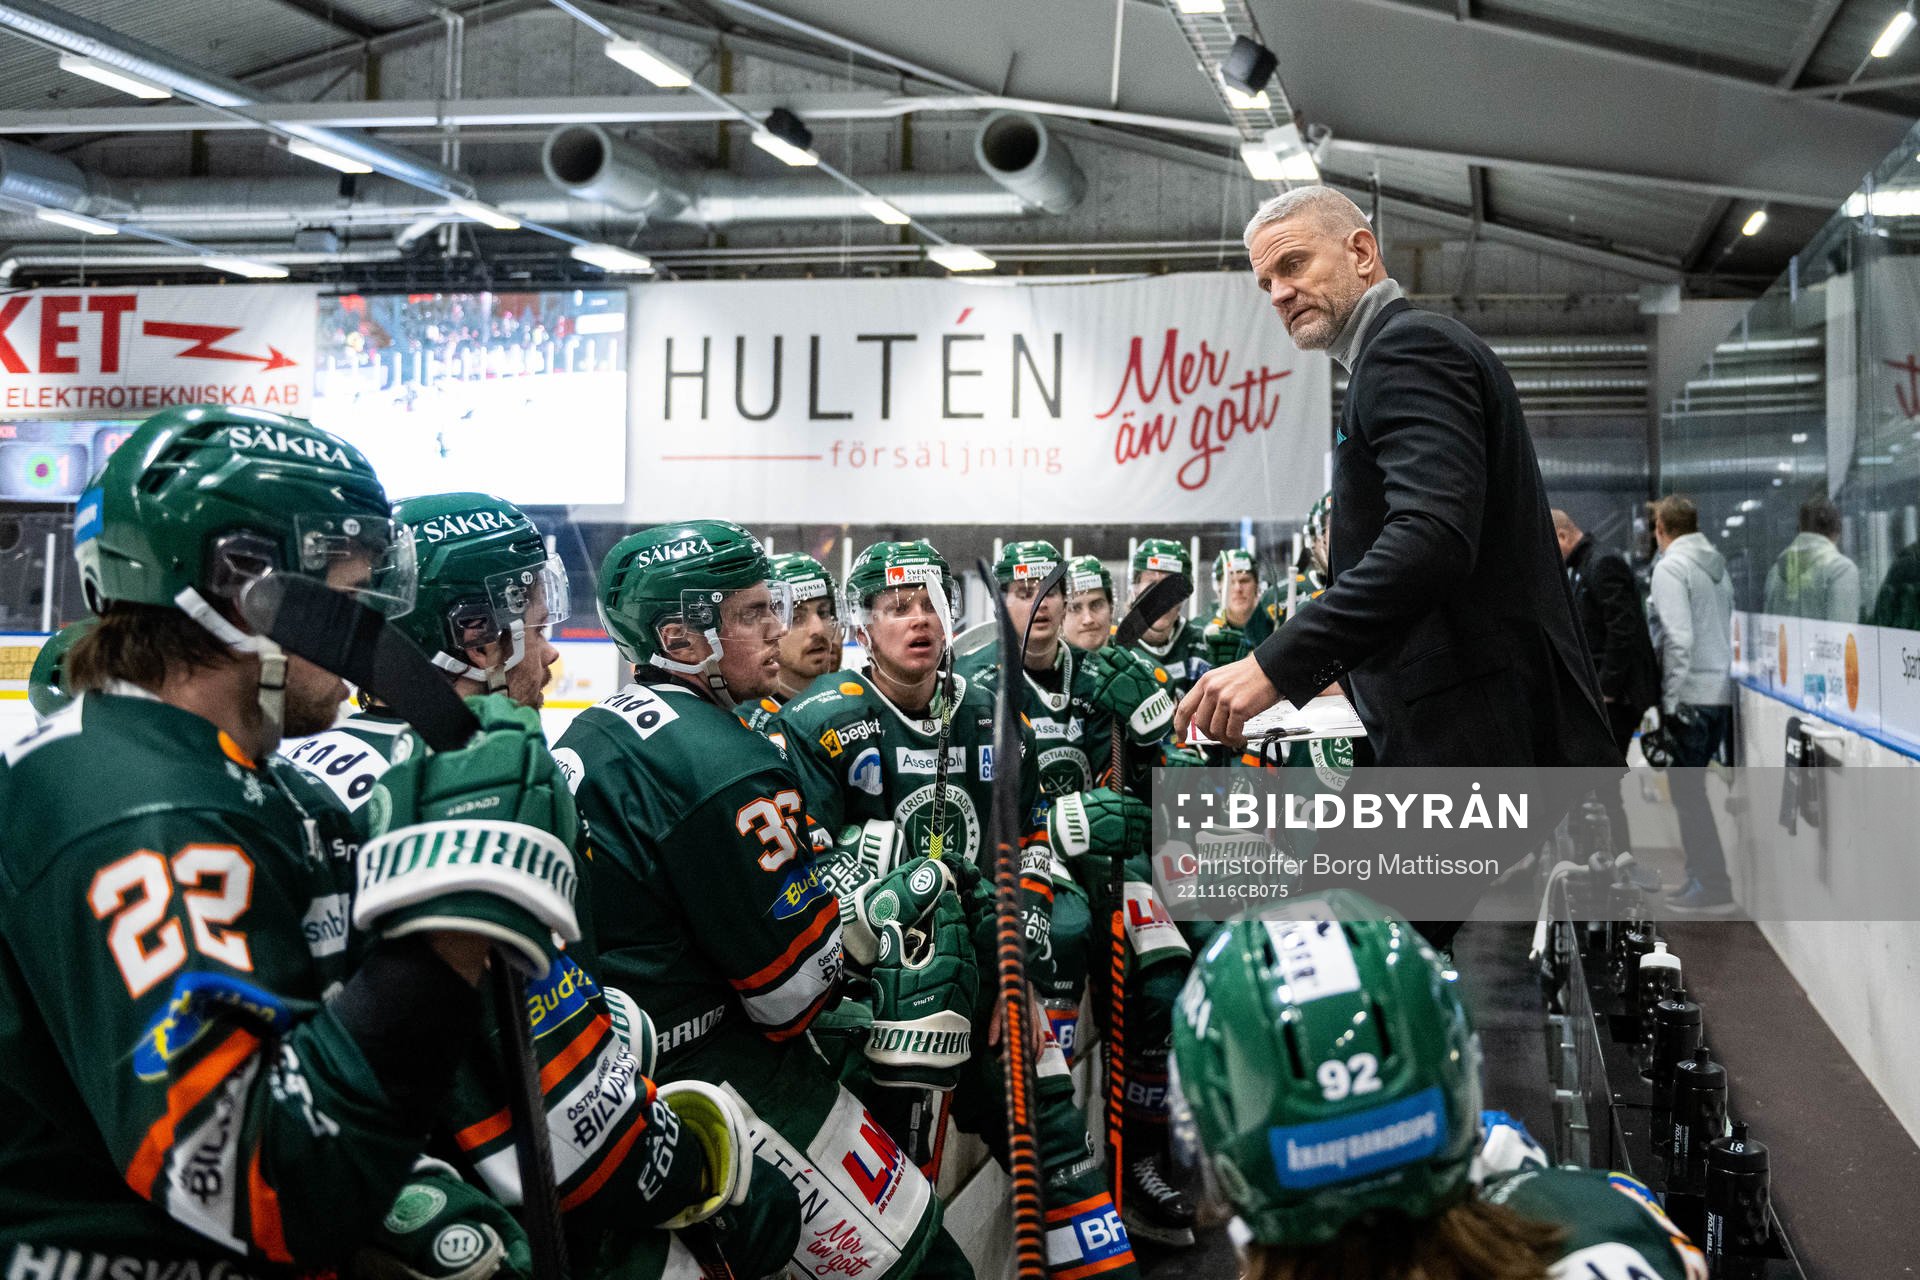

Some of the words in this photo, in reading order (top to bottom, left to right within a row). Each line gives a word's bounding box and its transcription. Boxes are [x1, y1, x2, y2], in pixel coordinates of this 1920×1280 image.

[663, 307, 1064, 421] HULTÉN
[1094, 328, 1228, 419] Mer
[7, 386, 257, 409] ELEKTROTEKNISKA
[263, 383, 300, 405] AB
[228, 425, 352, 470] SÄKRA
[1114, 414, 1178, 466] än
[1175, 369, 1291, 491] gott
[829, 439, 1064, 475] försäljning
[423, 509, 516, 544] SÄKRA
[637, 538, 714, 569] SÄKRA
[900, 788, 972, 816] KRISTISTADS
[87, 842, 254, 999] 22
[657, 1004, 726, 1054] RRIOR
[1317, 1052, 1383, 1101] 92
[1730, 1141, 1744, 1153] 18
[814, 1218, 864, 1254] Mer
